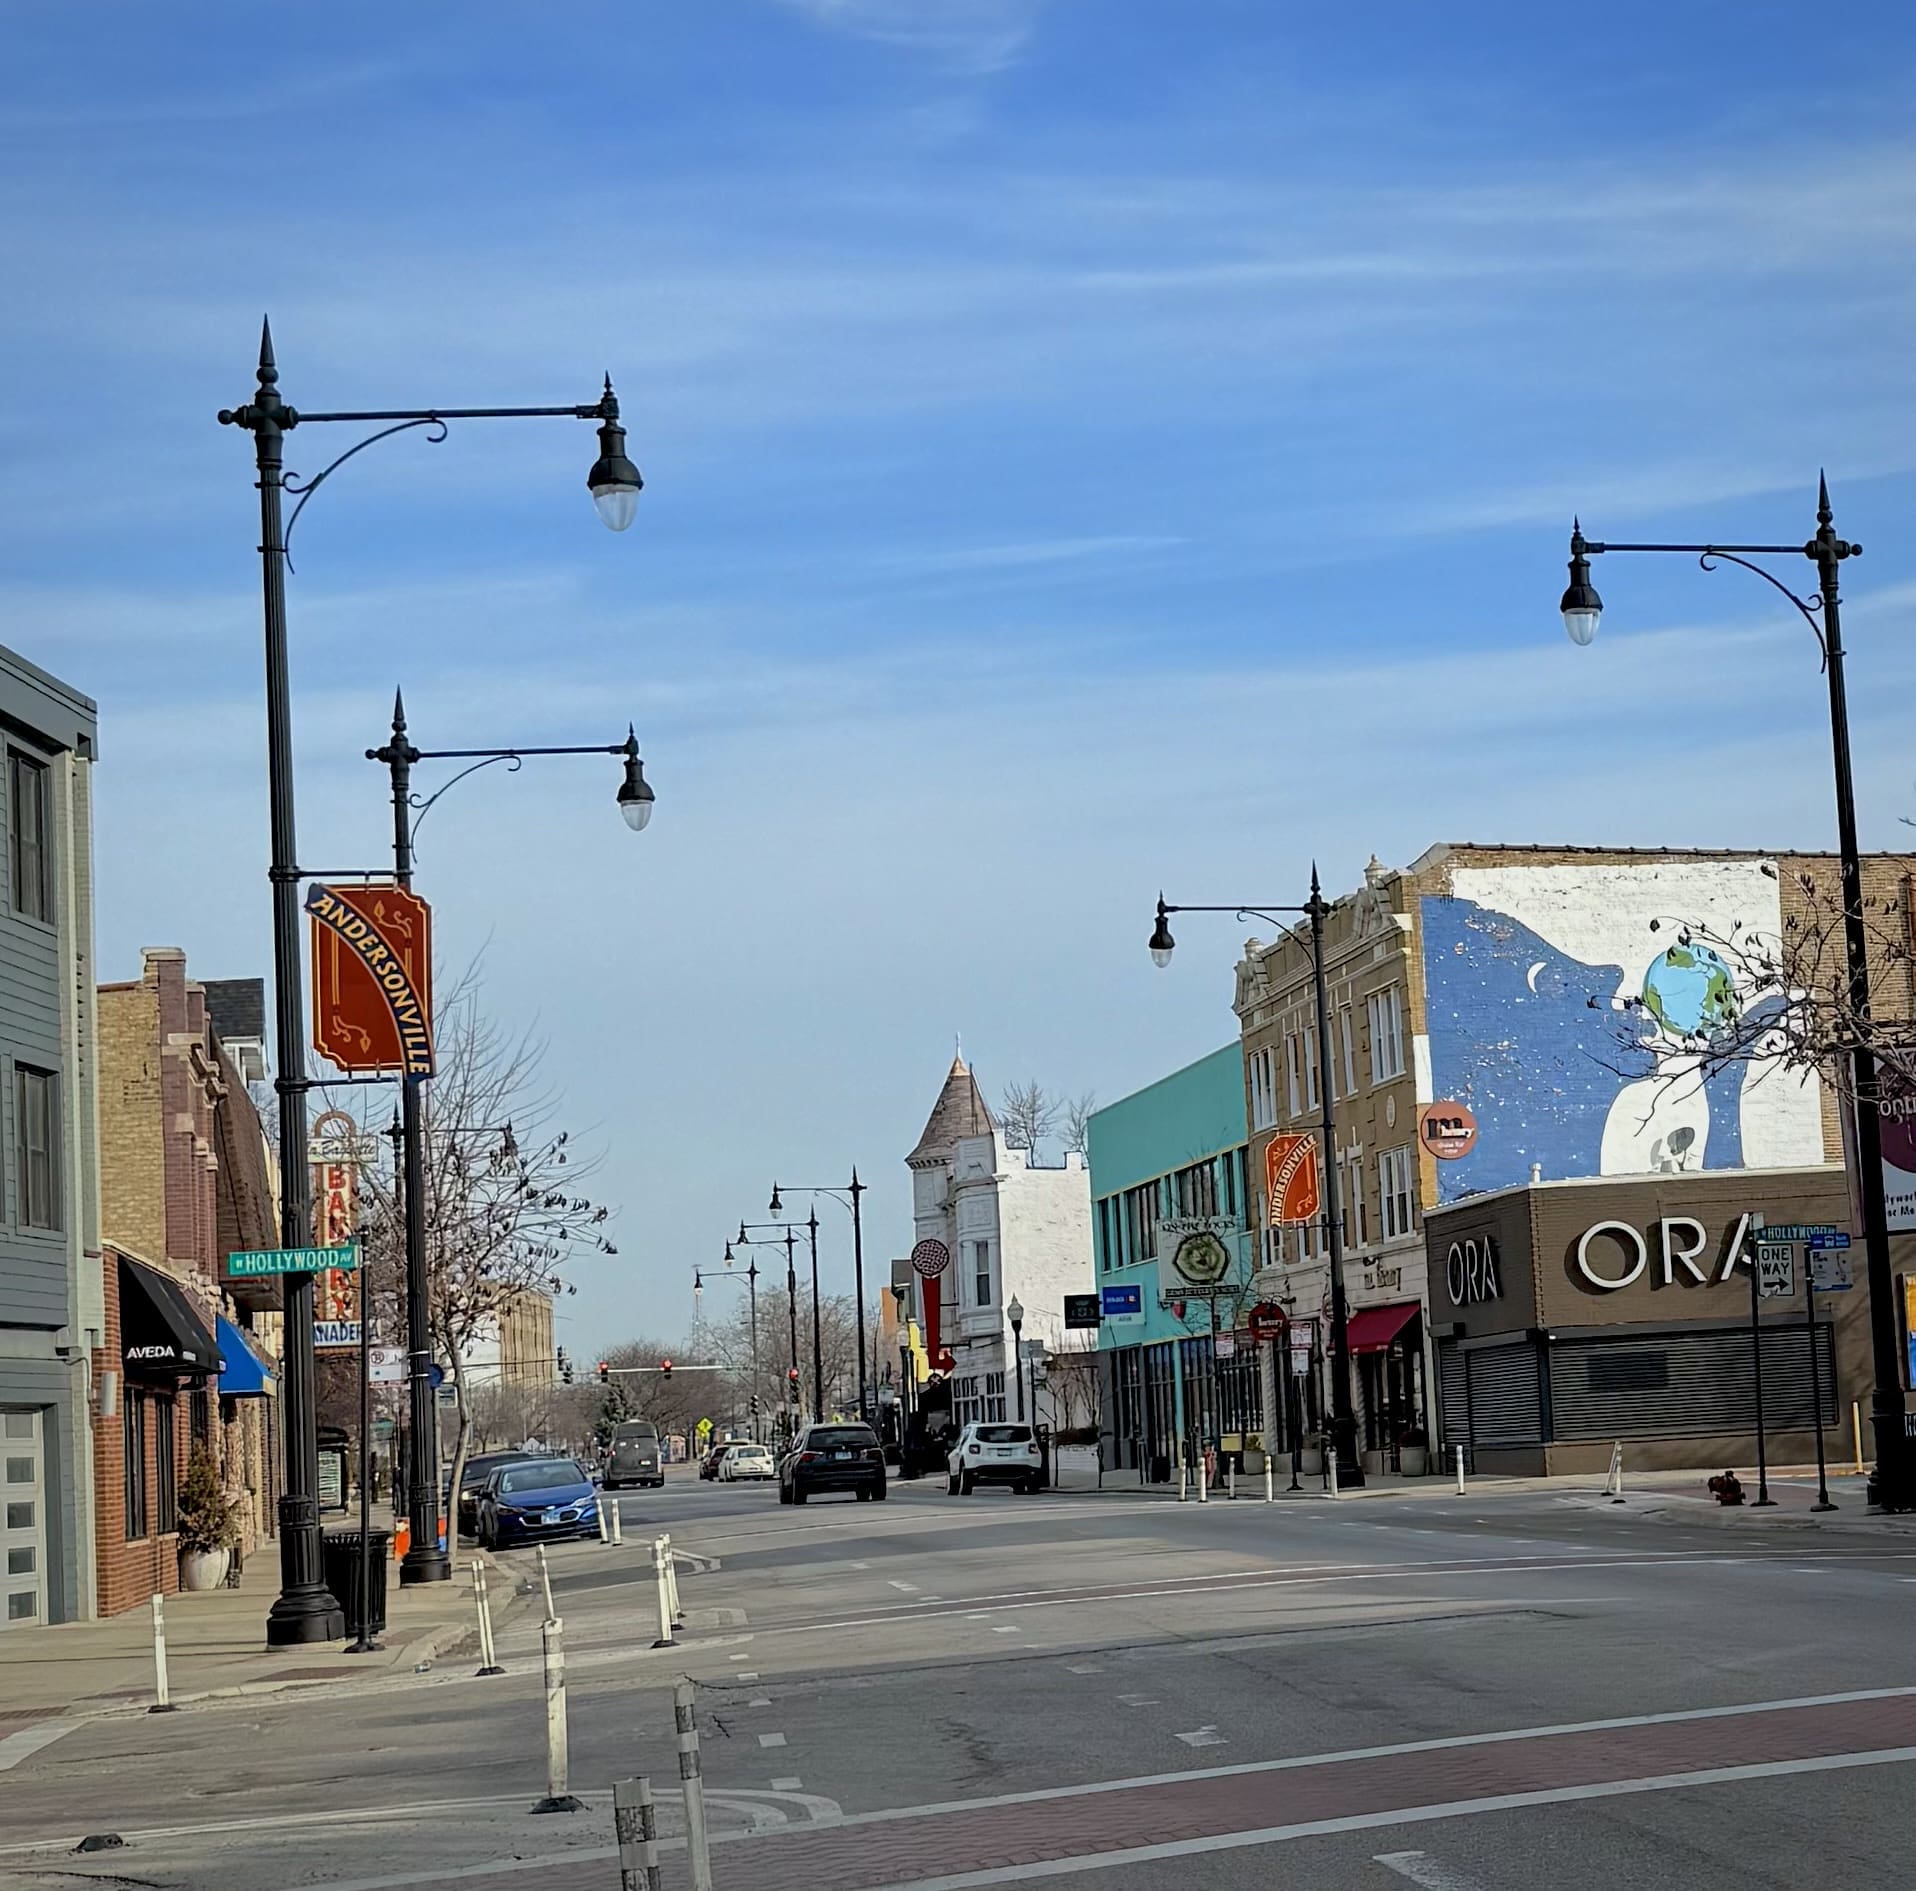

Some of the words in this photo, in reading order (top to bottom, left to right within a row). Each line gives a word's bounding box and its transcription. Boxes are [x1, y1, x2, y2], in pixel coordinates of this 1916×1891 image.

[310, 893, 430, 1074] ANDERSONVILLE
[1271, 1134, 1317, 1226] ANDERSONVILLE
[245, 1250, 339, 1273] HOLLYWOOD
[328, 1166, 348, 1319] BAKRY
[1762, 1248, 1790, 1261] ONE
[1447, 1235, 1498, 1305] ORA
[1761, 1263, 1790, 1276] WAY
[126, 1345, 176, 1360] AVEDA
